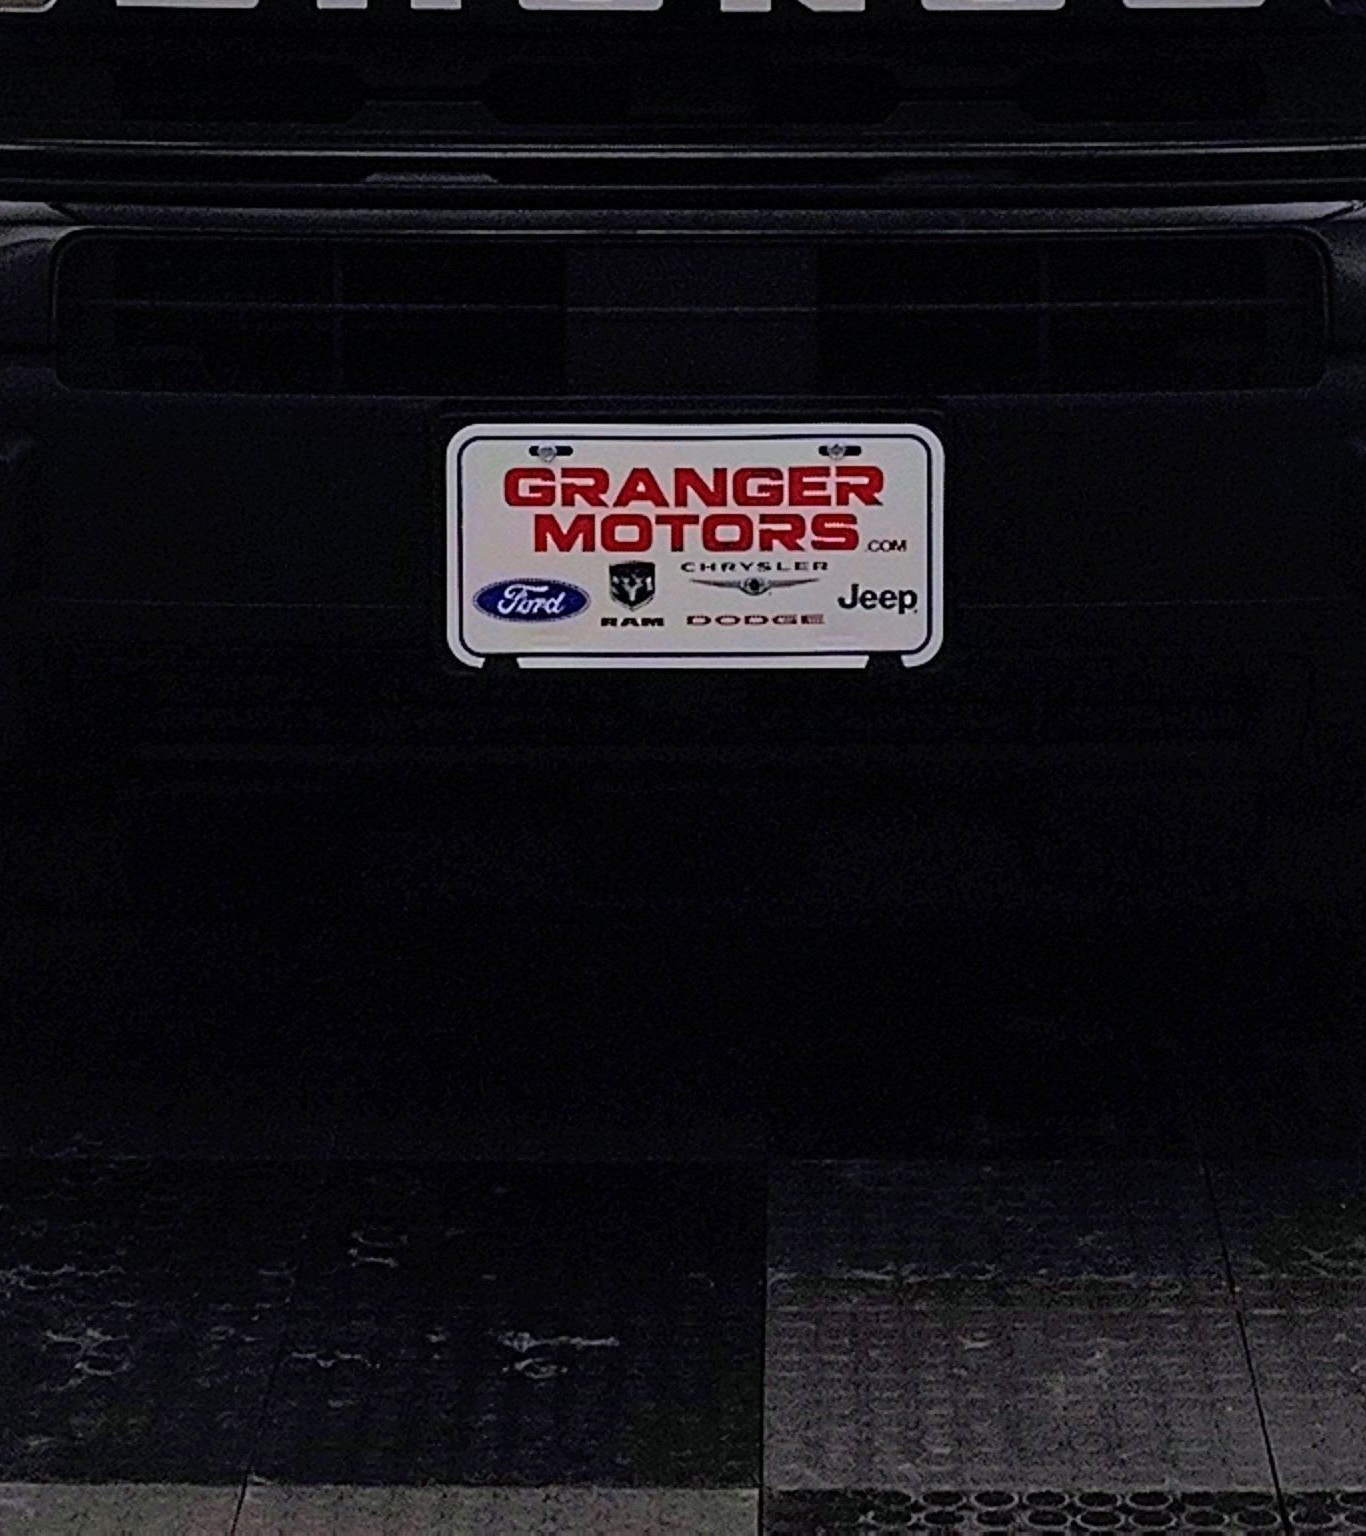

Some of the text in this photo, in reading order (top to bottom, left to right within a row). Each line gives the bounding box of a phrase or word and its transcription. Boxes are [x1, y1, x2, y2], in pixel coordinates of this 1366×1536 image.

[503, 465, 885, 507] GRANGER
[534, 513, 861, 553] MOTORS
[680, 560, 829, 573] CHRYSLER
[497, 582, 566, 617] Ford
[837, 583, 919, 614] Jeep
[600, 616, 665, 627] RAM
[685, 614, 826, 626] DODGE
